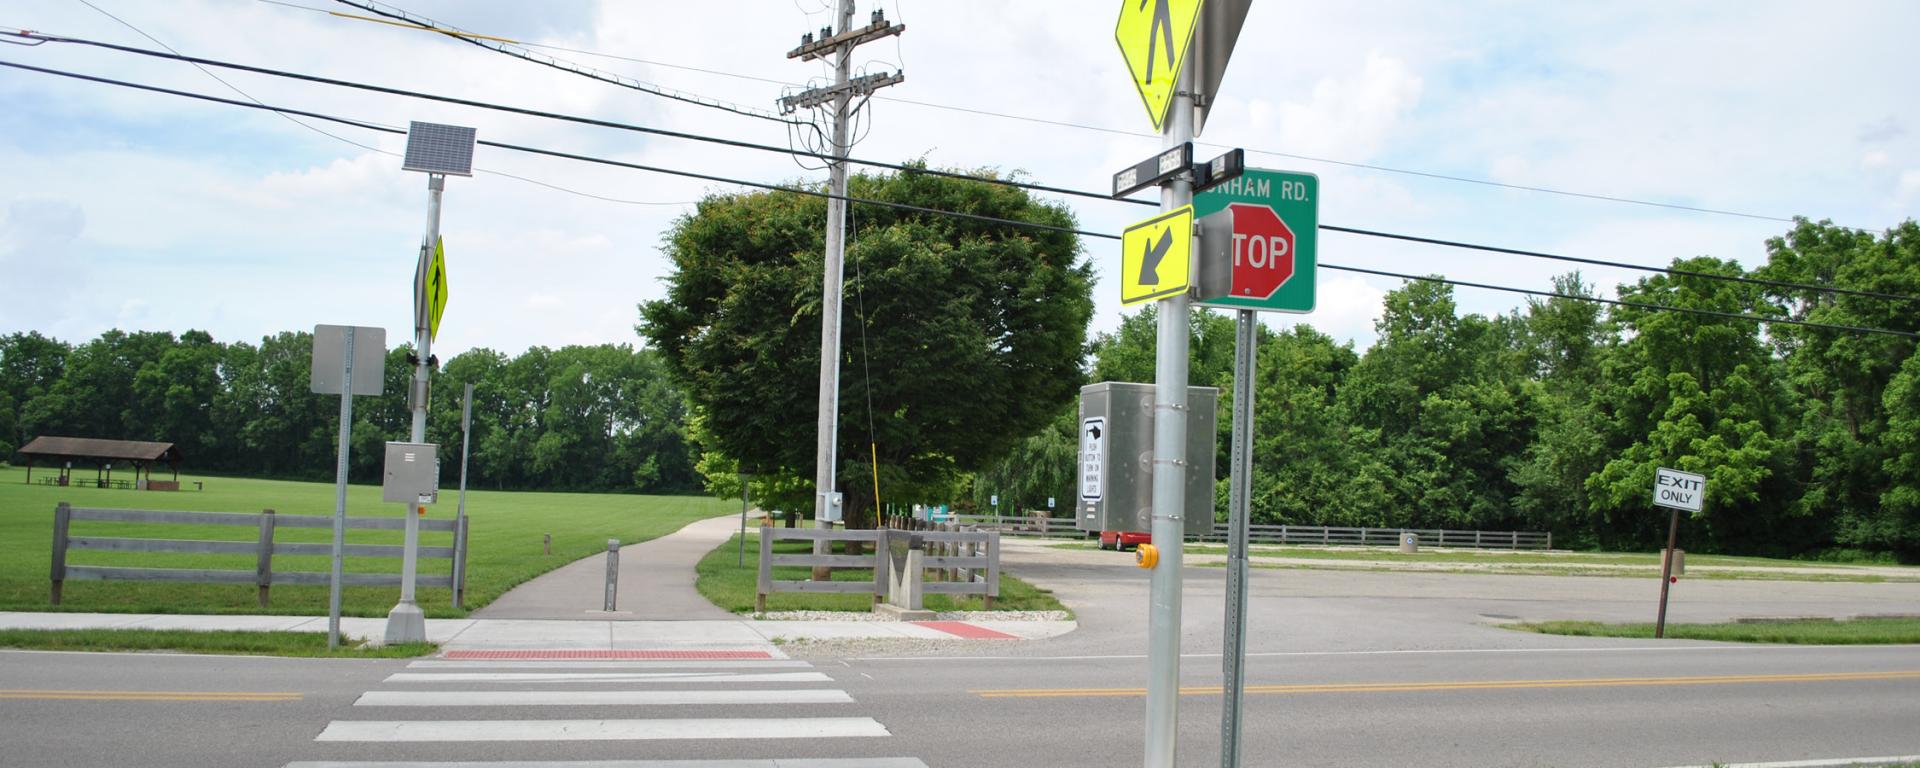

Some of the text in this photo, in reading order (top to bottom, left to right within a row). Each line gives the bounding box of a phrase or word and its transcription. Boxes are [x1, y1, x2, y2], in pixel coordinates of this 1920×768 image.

[1206, 175, 1310, 202] NHAM RD.
[1232, 233, 1289, 270] TOP
[1658, 475, 1702, 491] EXIT
[1661, 489, 1692, 504] ONLY
